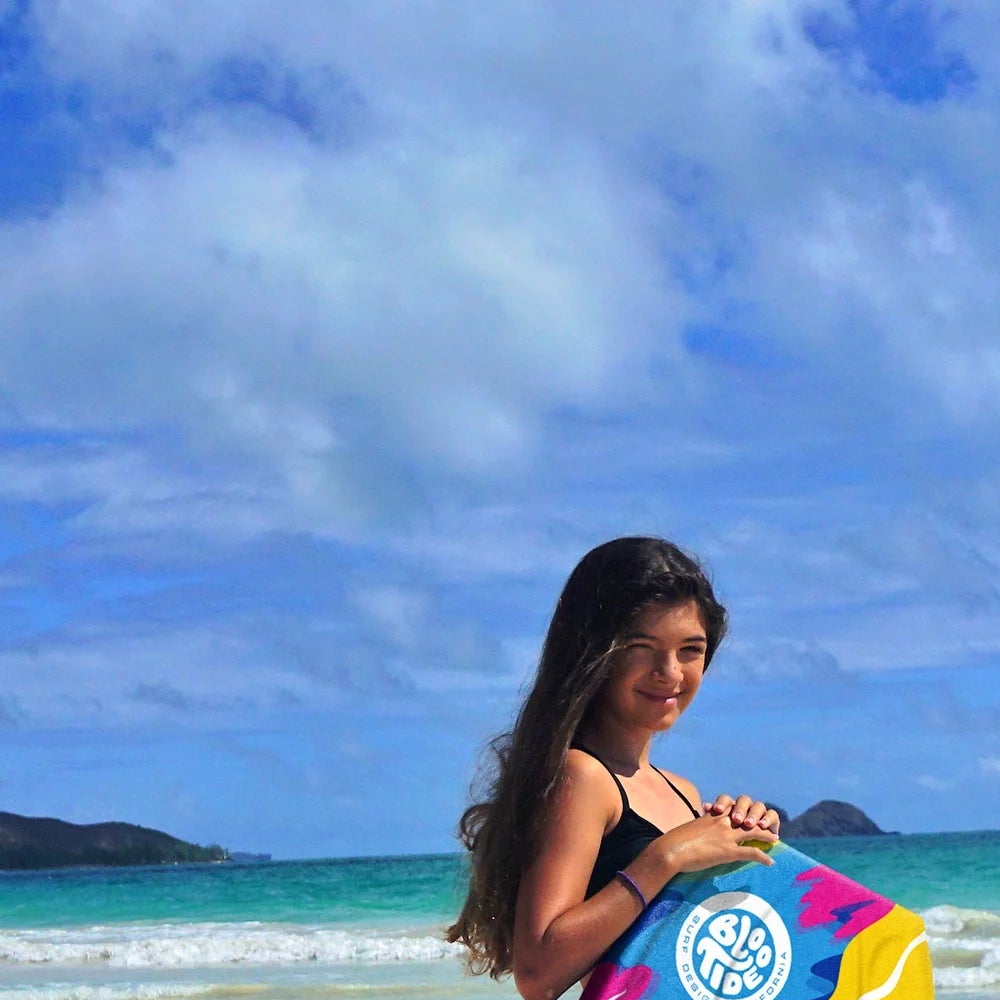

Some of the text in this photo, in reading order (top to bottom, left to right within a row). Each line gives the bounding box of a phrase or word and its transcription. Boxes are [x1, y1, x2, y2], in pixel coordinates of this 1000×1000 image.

[682, 915, 701, 954] SURF
[708, 913, 773, 968] BLOO
[696, 936, 764, 996] TIDE
